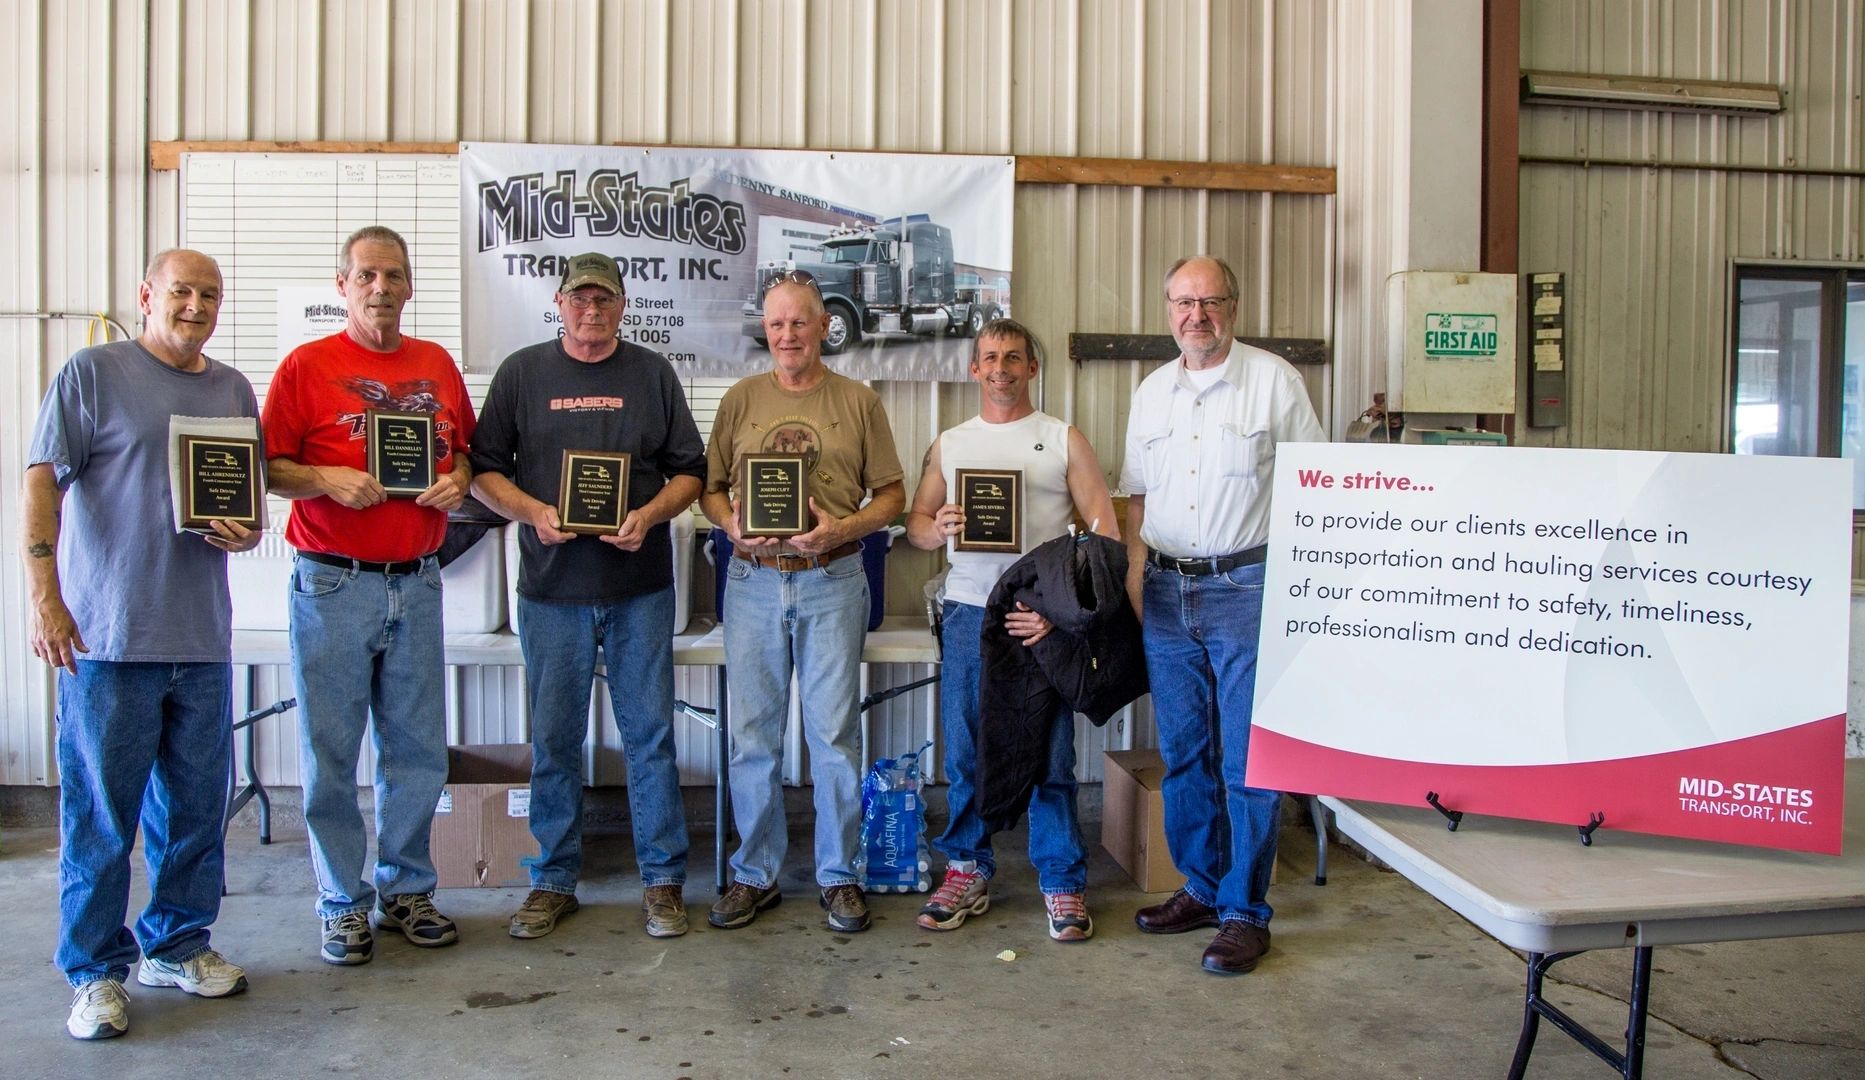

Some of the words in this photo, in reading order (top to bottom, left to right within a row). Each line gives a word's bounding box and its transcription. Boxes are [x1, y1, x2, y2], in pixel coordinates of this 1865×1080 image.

[730, 173, 776, 196] DENNY
[780, 189, 828, 210] SANFORD
[478, 169, 746, 255] Mid-States
[679, 258, 728, 280] INC.
[635, 297, 674, 309] Street
[623, 314, 642, 326] SD
[646, 316, 684, 327] 57108
[1426, 331, 1468, 348] FIRST
[1470, 332, 1497, 349] AID
[562, 396, 623, 408] SABERS
[1298, 469, 1334, 489] We
[1343, 471, 1434, 491] strive...
[1295, 511, 1314, 528] to
[1322, 511, 1402, 532] provide
[1410, 518, 1448, 533] our
[1456, 514, 1526, 536] clients
[1535, 519, 1657, 542] excellence
[1667, 524, 1688, 544] in
[1292, 546, 1442, 569] transportation
[1452, 552, 1495, 572] and
[1506, 552, 1593, 582] hauling
[1603, 562, 1697, 584] services
[1707, 570, 1812, 596] courtesy
[1289, 578, 1310, 597] of
[1317, 585, 1353, 600] our
[1360, 586, 1500, 609] commitment
[1508, 593, 1530, 611] to
[1538, 593, 1612, 621] safety,
[1621, 599, 1752, 631] timeliness,
[1286, 615, 1455, 644] professionalism
[1465, 627, 1509, 648] and
[1518, 629, 1652, 658] dedication.
[1679, 777, 1813, 807] MID-STATES
[1679, 798, 1775, 822] TRANSPORT,
[1780, 809, 1812, 825] INC.
[884, 812, 900, 868] AQUAFINA
